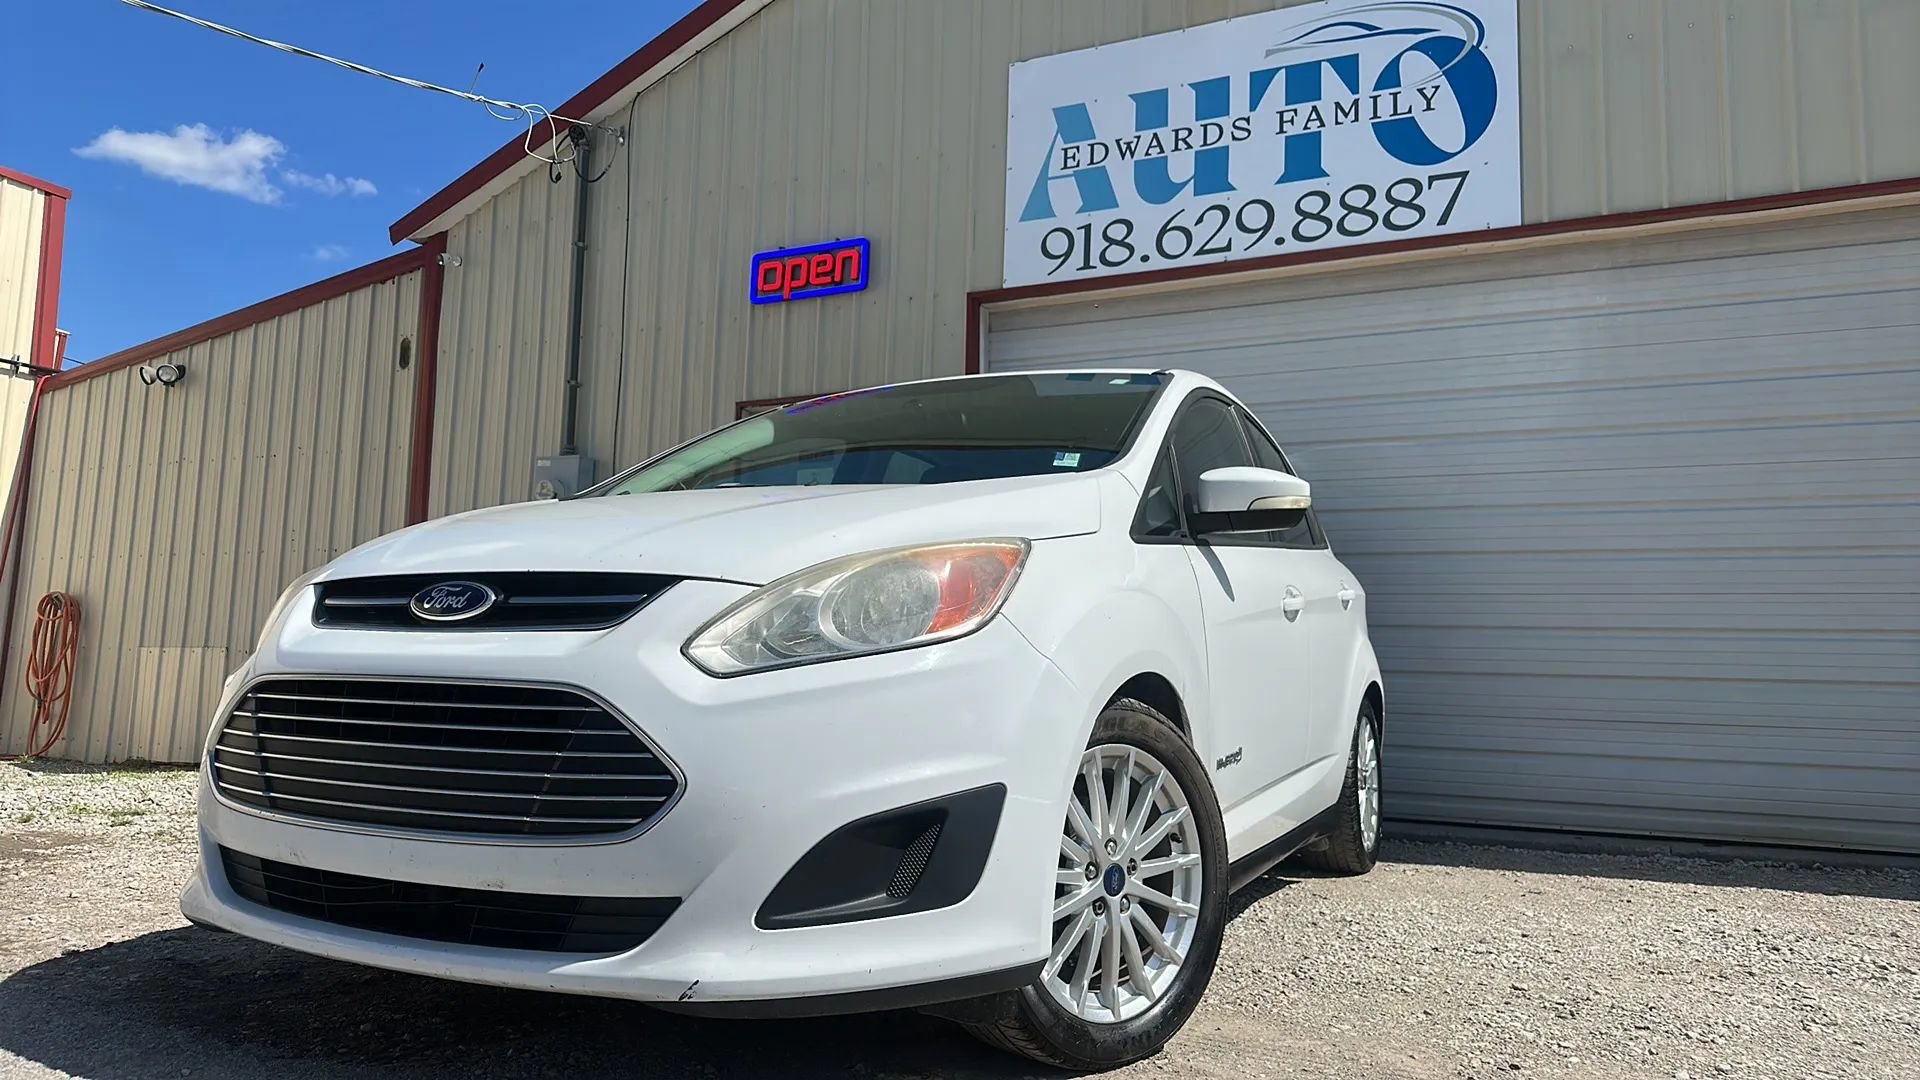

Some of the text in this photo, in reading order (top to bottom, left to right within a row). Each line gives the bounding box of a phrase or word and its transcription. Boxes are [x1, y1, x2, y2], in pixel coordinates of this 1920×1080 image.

[1018, 35, 1498, 222] AUTO
[1060, 84, 1441, 171] EDWARDS FAMILY
[1040, 170, 1470, 276] 918.629.8887
[757, 248, 860, 301] open
[423, 585, 473, 609] Ford
